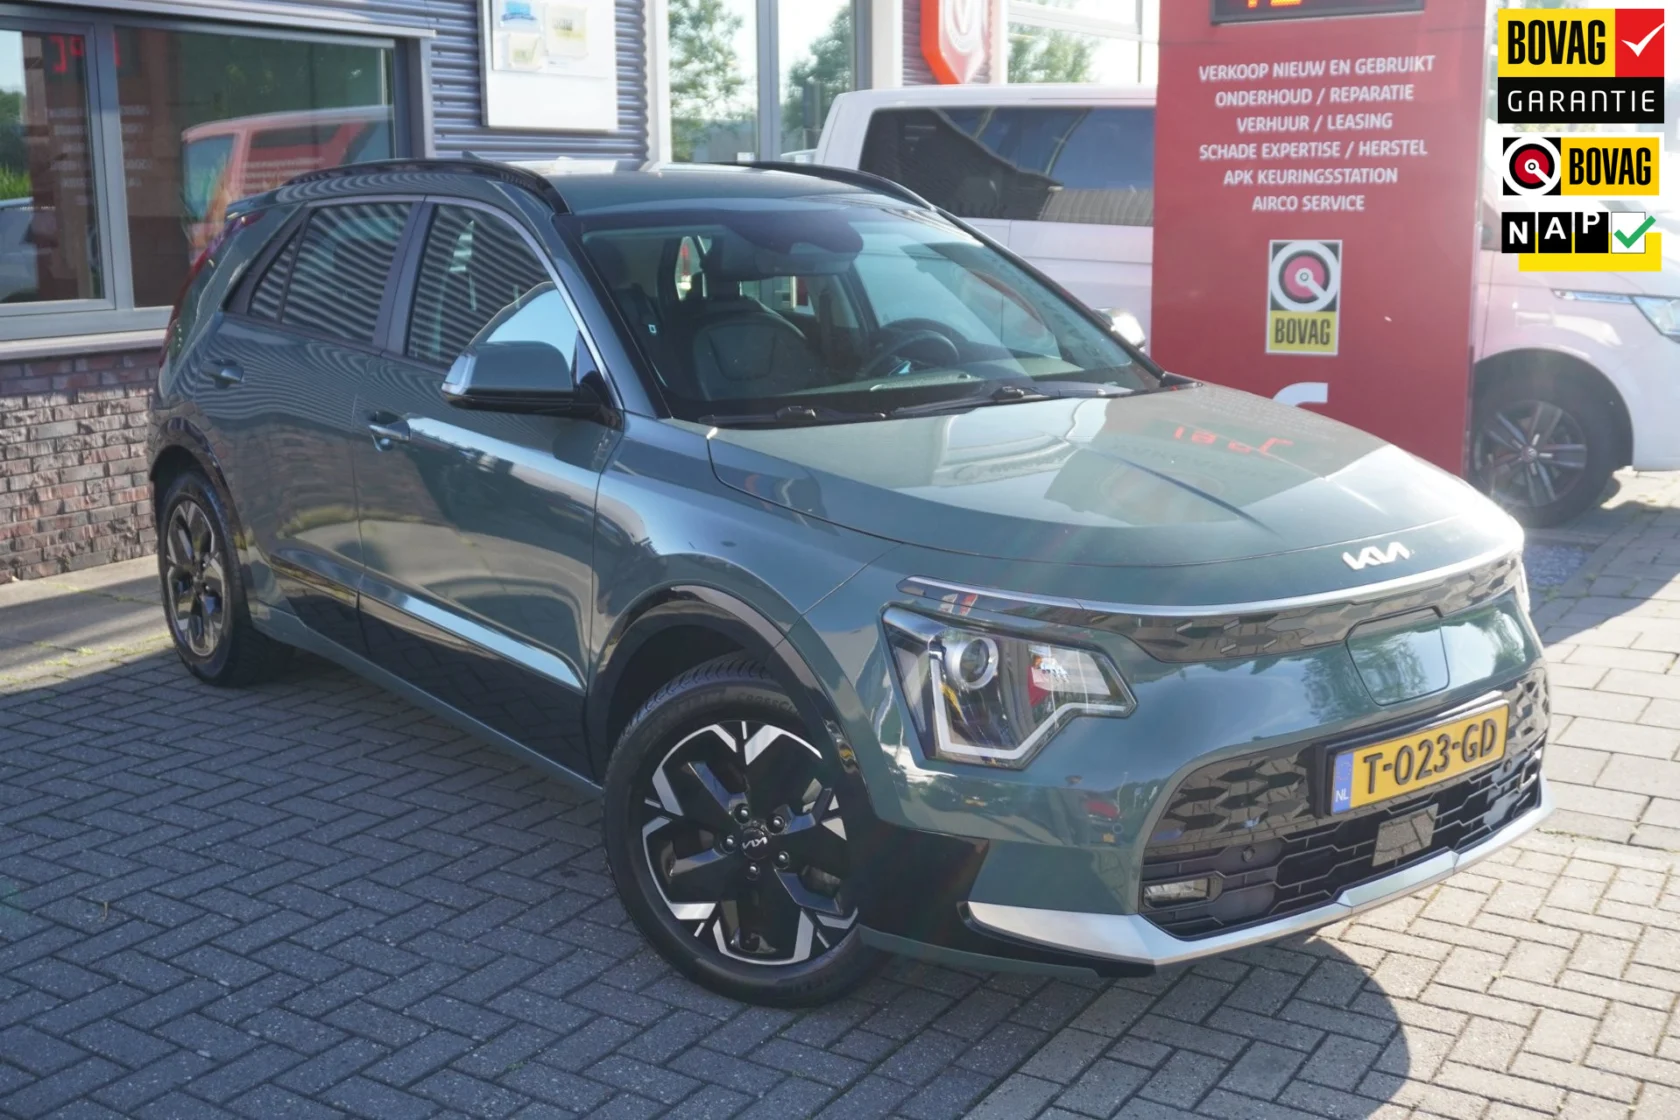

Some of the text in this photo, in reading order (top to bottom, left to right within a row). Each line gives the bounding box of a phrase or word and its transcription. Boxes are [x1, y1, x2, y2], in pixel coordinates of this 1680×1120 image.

[1199, 55, 1436, 81] VERKOOP NIEUW EN GEBRUIKT
[1215, 88, 1313, 107] ONDERHOUD
[1330, 84, 1415, 103] REPARATIE
[1236, 115, 1310, 133] VERHUUR
[1327, 112, 1393, 131] LEASING
[1199, 143, 1257, 160] SCHADE
[1261, 141, 1341, 159] EXPERTISE
[1358, 139, 1428, 157] HERSTEL
[1223, 167, 1398, 186] APK KEURINGSSTATION
[1252, 194, 1366, 212] AIRCO SERVICE
[1273, 316, 1331, 347] BOVAG
[1363, 718, 1498, 795] T-023-GD
[1335, 788, 1349, 803] NL
